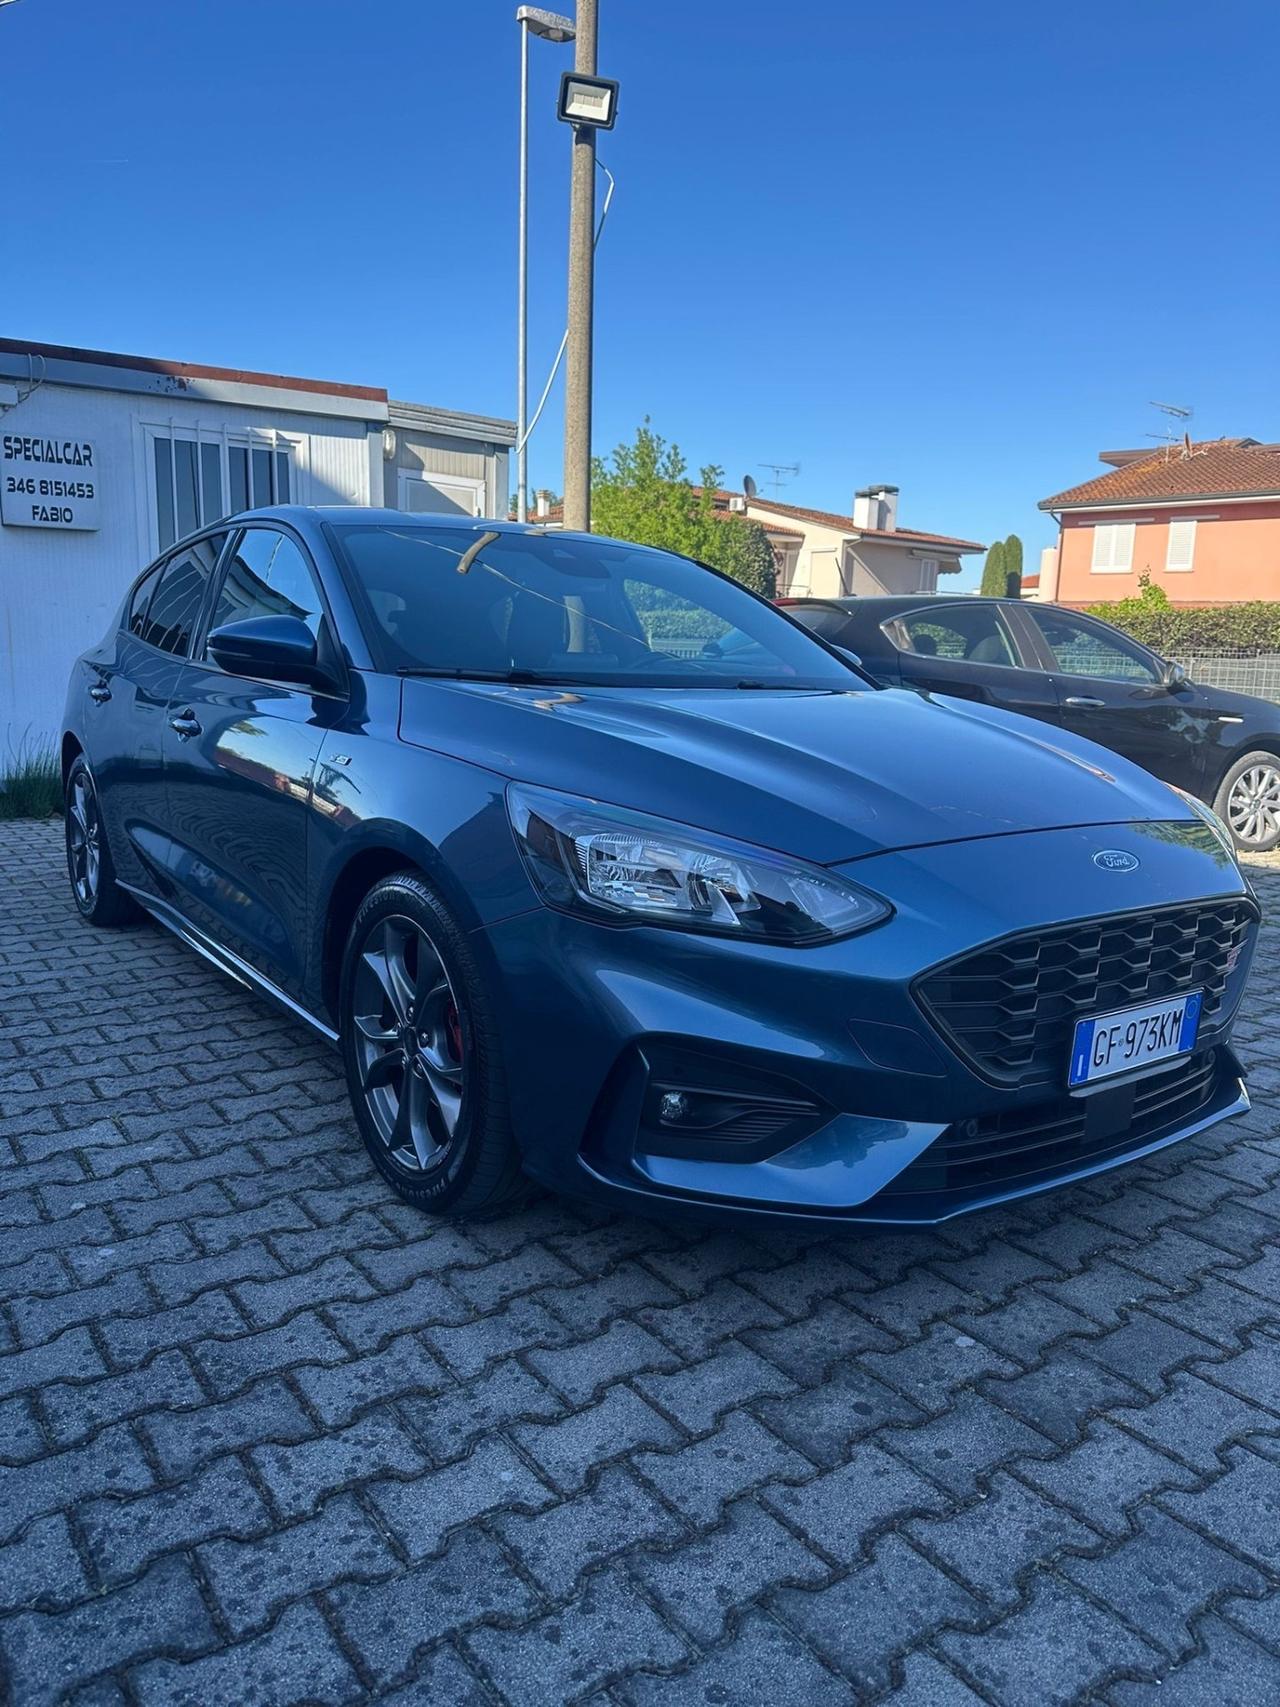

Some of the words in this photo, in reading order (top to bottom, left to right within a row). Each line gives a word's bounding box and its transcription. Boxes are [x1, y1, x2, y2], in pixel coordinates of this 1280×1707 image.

[3, 436, 93, 467] SPECIALCAR
[7, 476, 36, 495] 346
[40, 480, 95, 499] 8151453
[32, 505, 74, 523] FABIO
